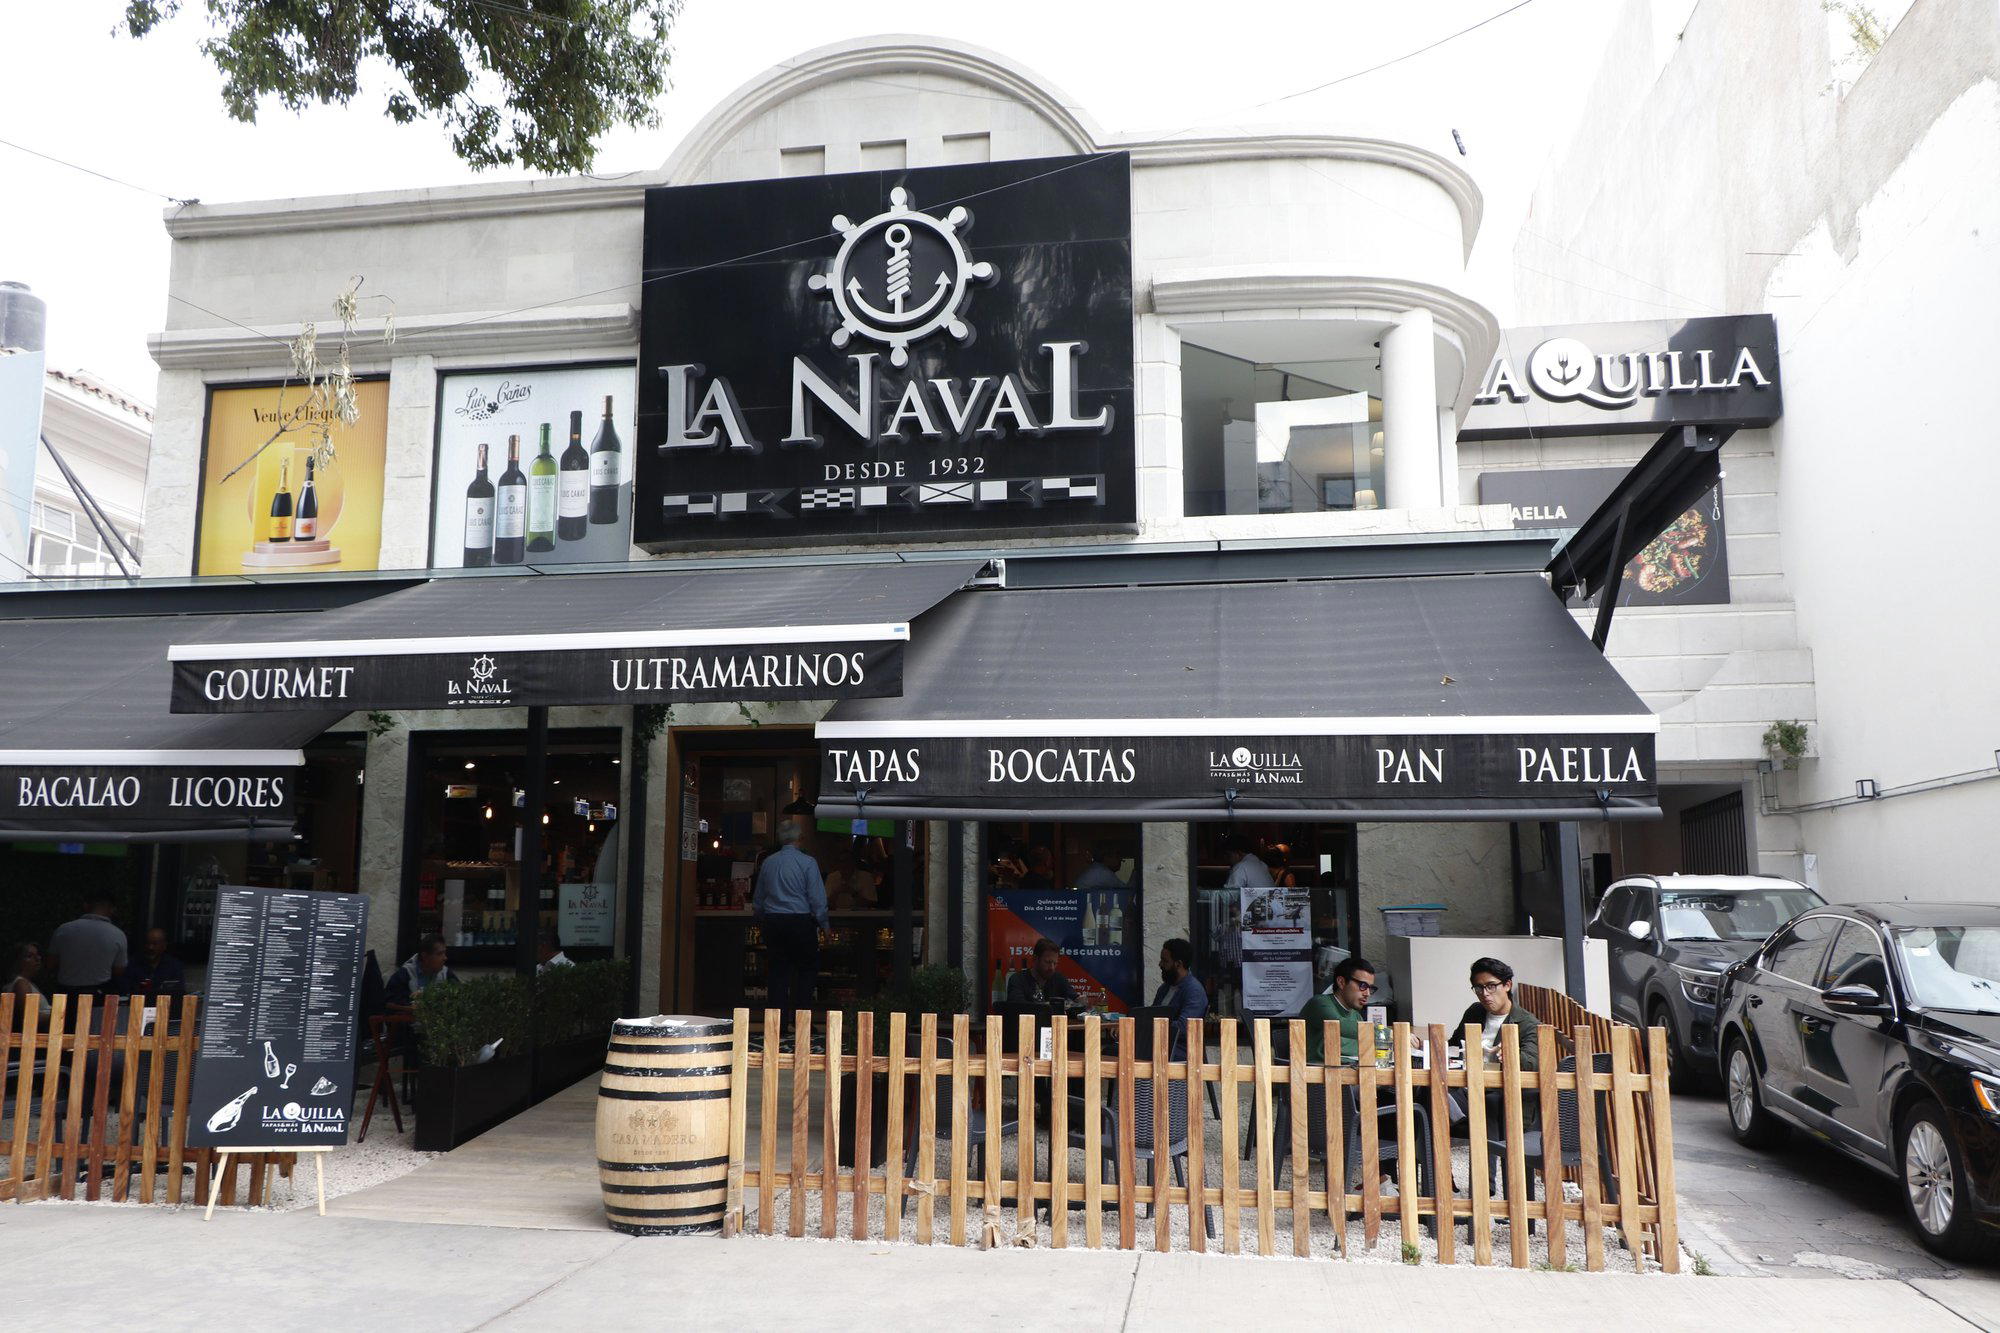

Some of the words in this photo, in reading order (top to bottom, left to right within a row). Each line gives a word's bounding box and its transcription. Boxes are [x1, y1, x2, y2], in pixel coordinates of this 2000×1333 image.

[1475, 358, 1528, 399] A
[1532, 338, 1771, 405] QUILLA
[455, 387, 487, 415] Luis
[496, 380, 532, 404] Cañas
[658, 364, 754, 450] LA
[780, 342, 1109, 442] NAVAL
[254, 407, 291, 422] Veuve
[824, 460, 906, 482] DESDE
[928, 456, 986, 477] 1932
[1511, 506, 1568, 520] AELLA
[205, 667, 354, 702] GOURMET
[611, 652, 865, 691] ULTRAMARINOS
[448, 680, 462, 694] LA
[466, 679, 512, 694] NAVAL
[828, 748, 920, 783] TAPAS
[987, 748, 1135, 783] BOCATAS
[1210, 751, 1231, 767] LA
[1232, 747, 1303, 770] QUILLA
[1376, 749, 1444, 784] PAN
[1517, 746, 1646, 783] PAELLA
[1255, 772, 1267, 783] LA
[1268, 772, 1303, 783] NAVAL
[18, 775, 140, 808] BACALAO
[169, 775, 284, 808] LICORES
[1009, 946, 1034, 956] 15%
[262, 1105, 281, 1119] LA
[282, 1102, 344, 1122] QUILLA
[301, 1122, 312, 1133] LA
[314, 1122, 344, 1132] NAVAL
